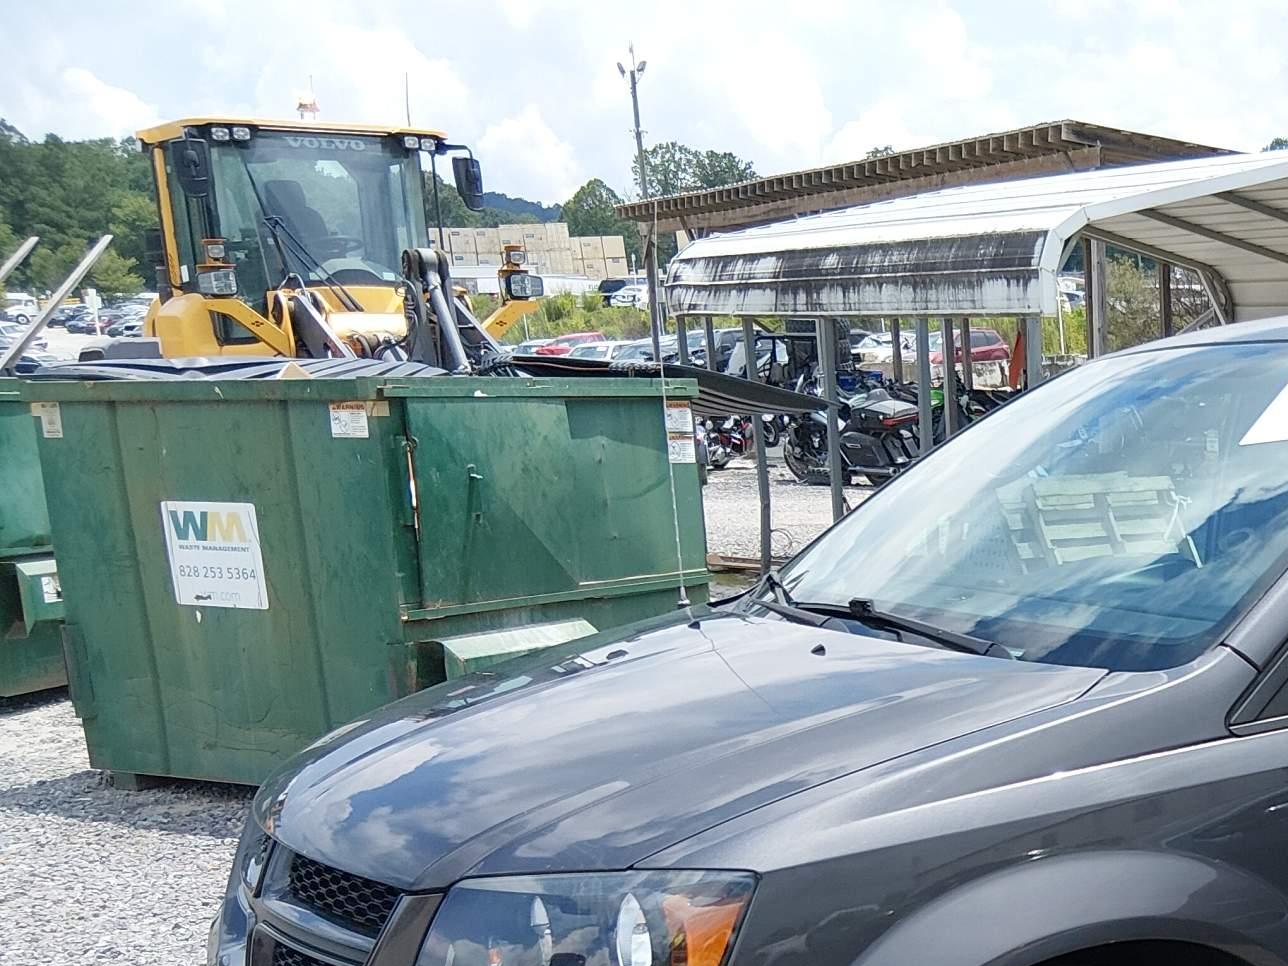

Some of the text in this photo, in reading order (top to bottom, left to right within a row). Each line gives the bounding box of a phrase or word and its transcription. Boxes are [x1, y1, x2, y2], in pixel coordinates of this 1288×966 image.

[285, 136, 365, 151] VOLVO
[169, 510, 248, 543] WM
[179, 565, 256, 580] 828 253 5364
